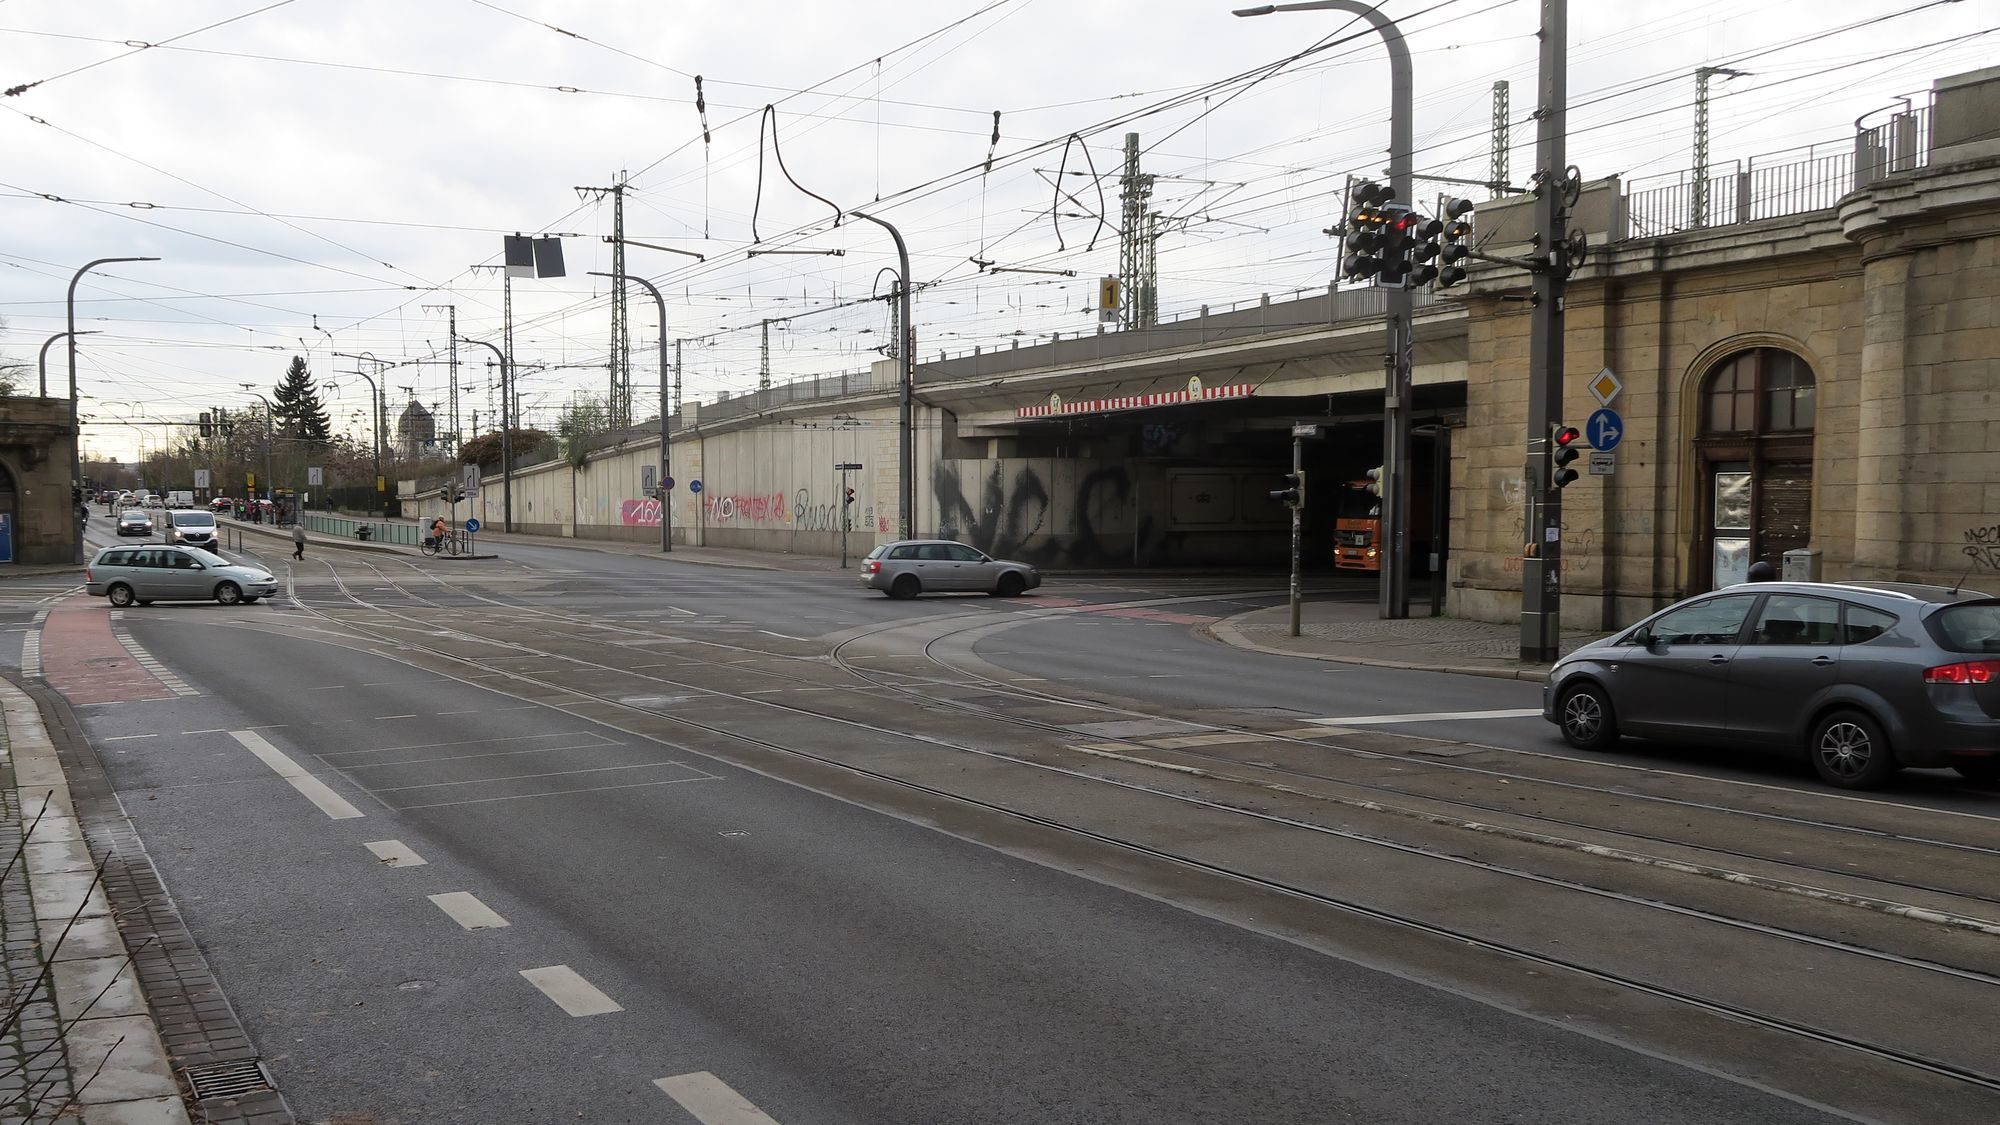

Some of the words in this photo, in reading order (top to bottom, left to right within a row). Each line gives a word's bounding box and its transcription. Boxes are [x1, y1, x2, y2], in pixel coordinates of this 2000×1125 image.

[1106, 284, 1114, 305] 1
[630, 501, 664, 524] 161
[710, 497, 734, 520] NO
